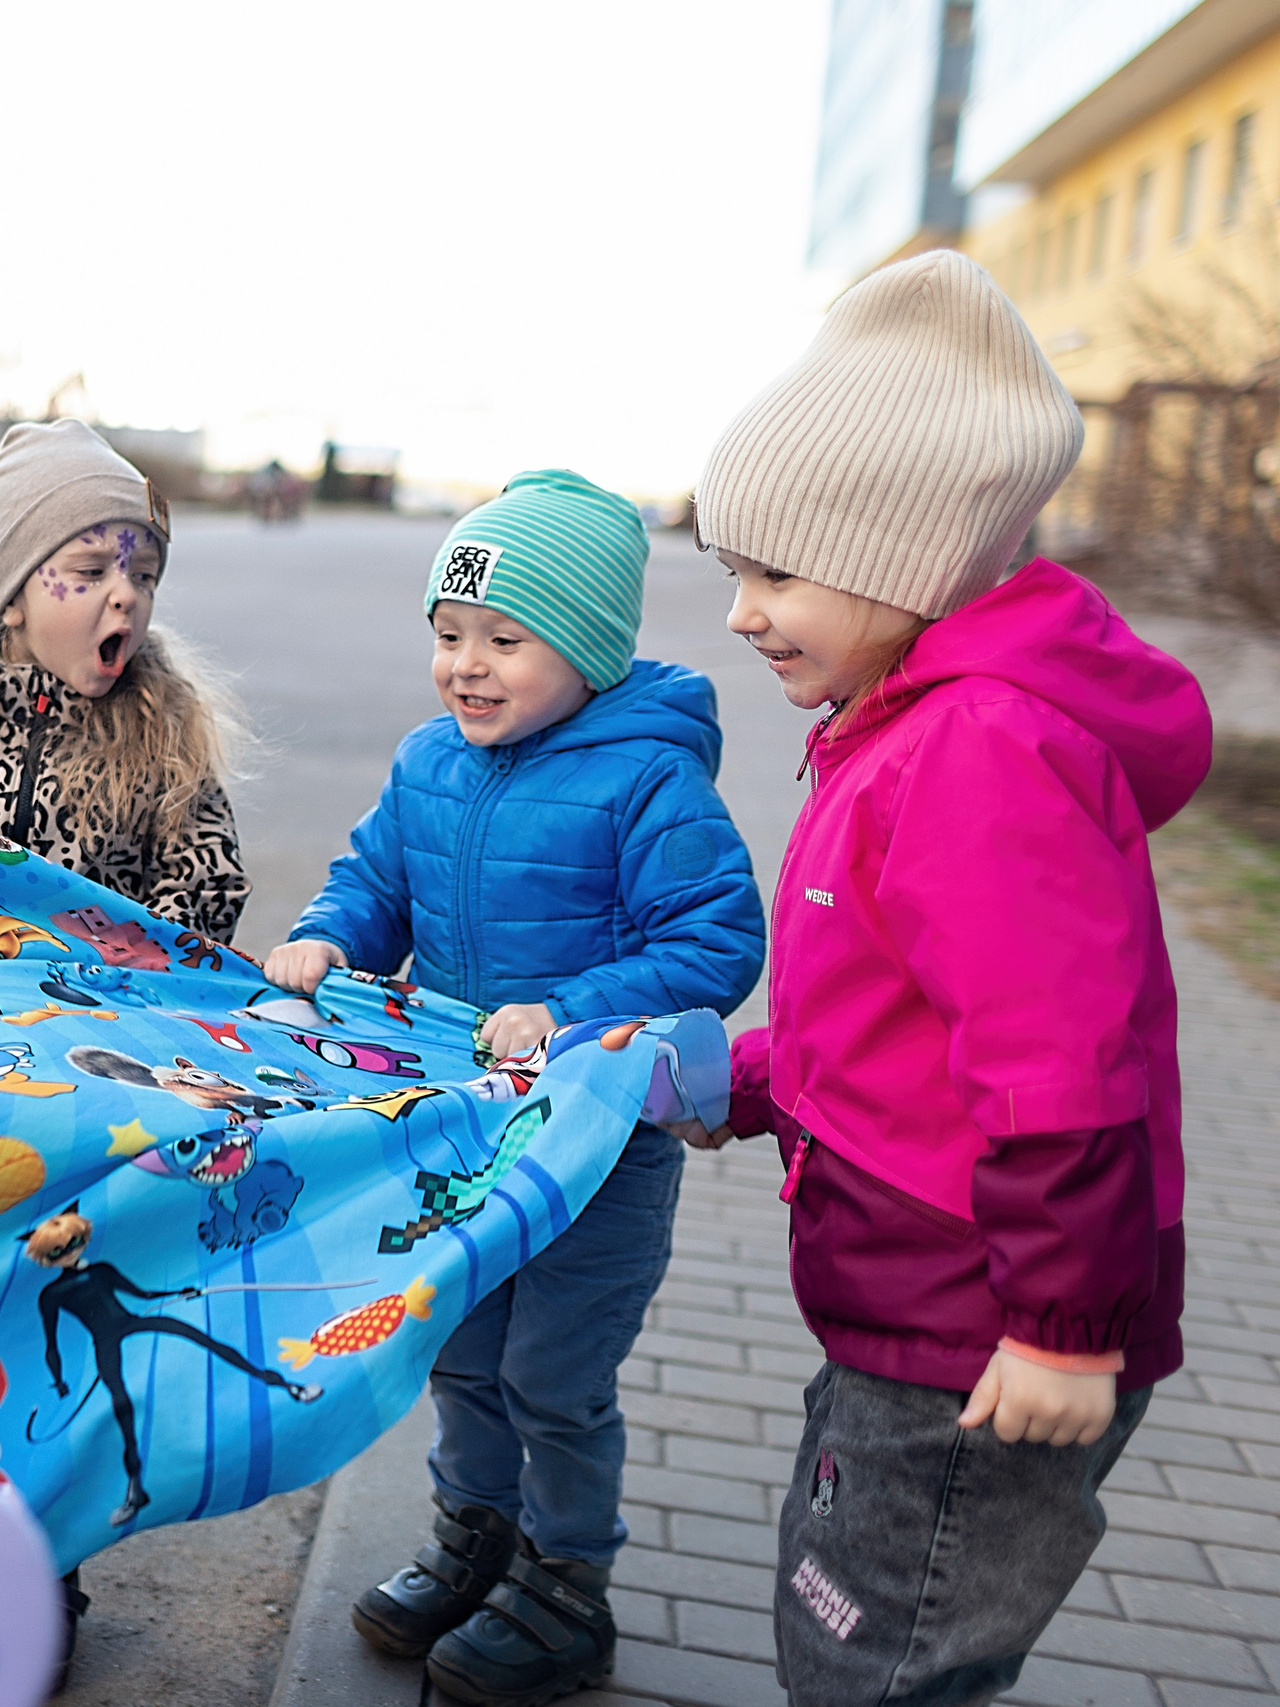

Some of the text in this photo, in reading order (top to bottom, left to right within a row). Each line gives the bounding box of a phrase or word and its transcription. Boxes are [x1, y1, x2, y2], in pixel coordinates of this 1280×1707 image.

[451, 546, 492, 565] GEG
[446, 560, 487, 582] GAM
[441, 576, 479, 599] OJA
[805, 887, 834, 907] WEDZE
[800, 1557, 862, 1626] MINNIE
[791, 1569, 853, 1640] MOUSE
